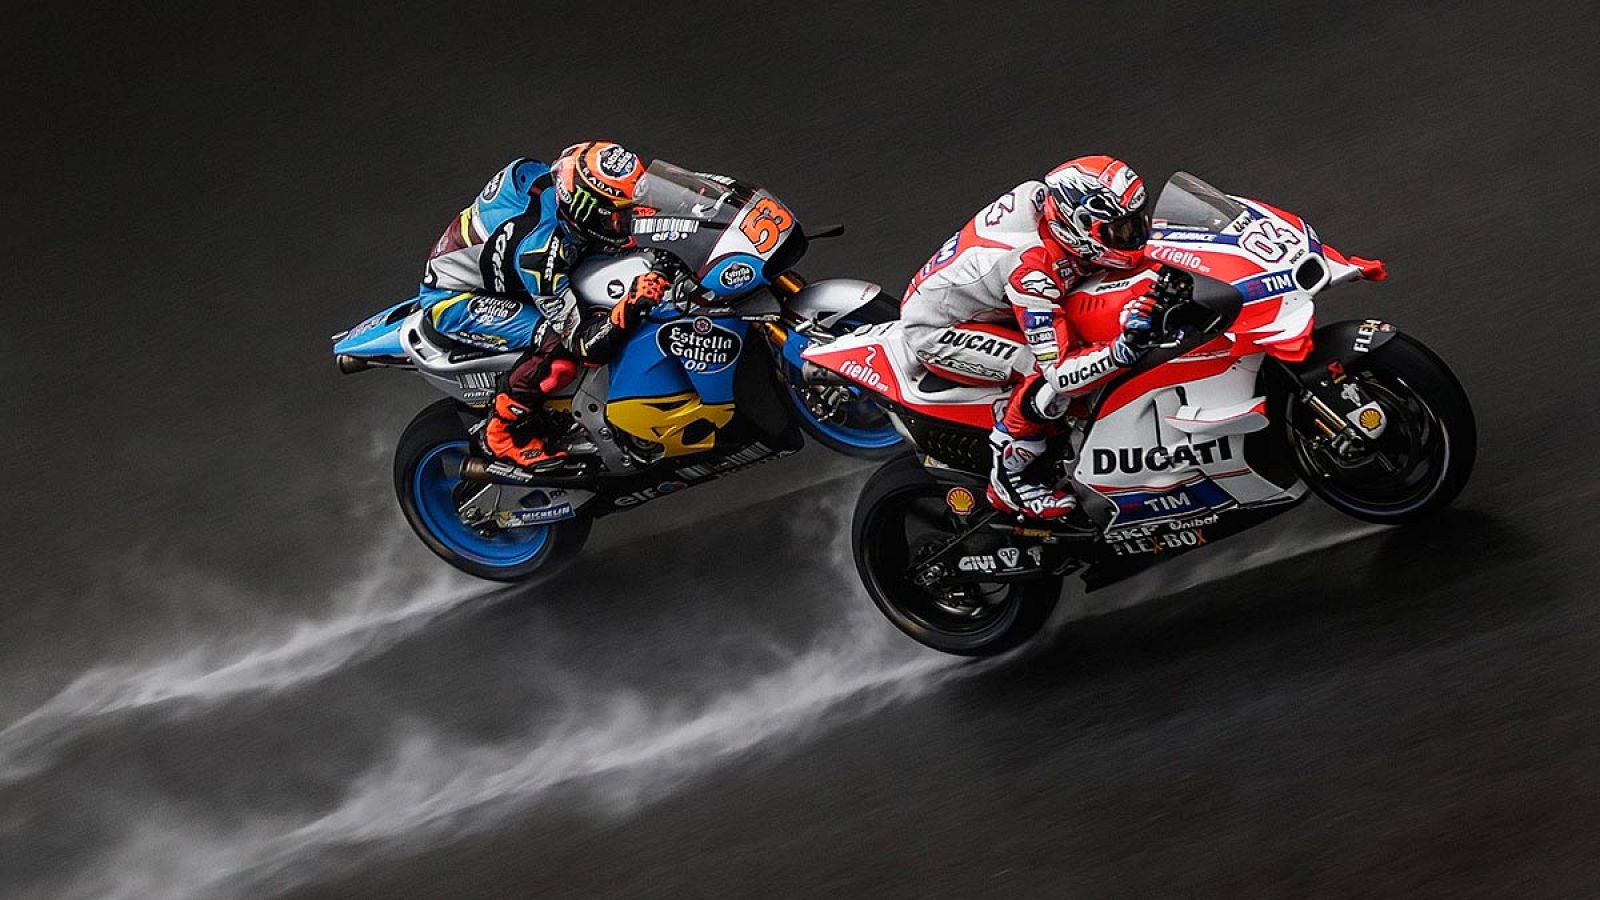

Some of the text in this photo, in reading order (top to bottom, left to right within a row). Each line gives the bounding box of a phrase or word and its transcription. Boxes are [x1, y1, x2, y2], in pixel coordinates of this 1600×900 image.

[739, 196, 793, 253] 53
[1243, 220, 1301, 263] 04
[1161, 248, 1201, 269] riello
[1261, 274, 1293, 292] TIM
[669, 327, 732, 349] Estrella
[938, 330, 1018, 360] DUCATI
[670, 341, 728, 363] Galicia
[840, 360, 881, 386] riello
[1058, 354, 1114, 388] DUCATI
[1093, 436, 1232, 476] DUCATI
[614, 485, 658, 506] elf
[1144, 492, 1191, 513] TIM
[522, 506, 570, 521] MICHELIN
[958, 555, 997, 571] GIVI
